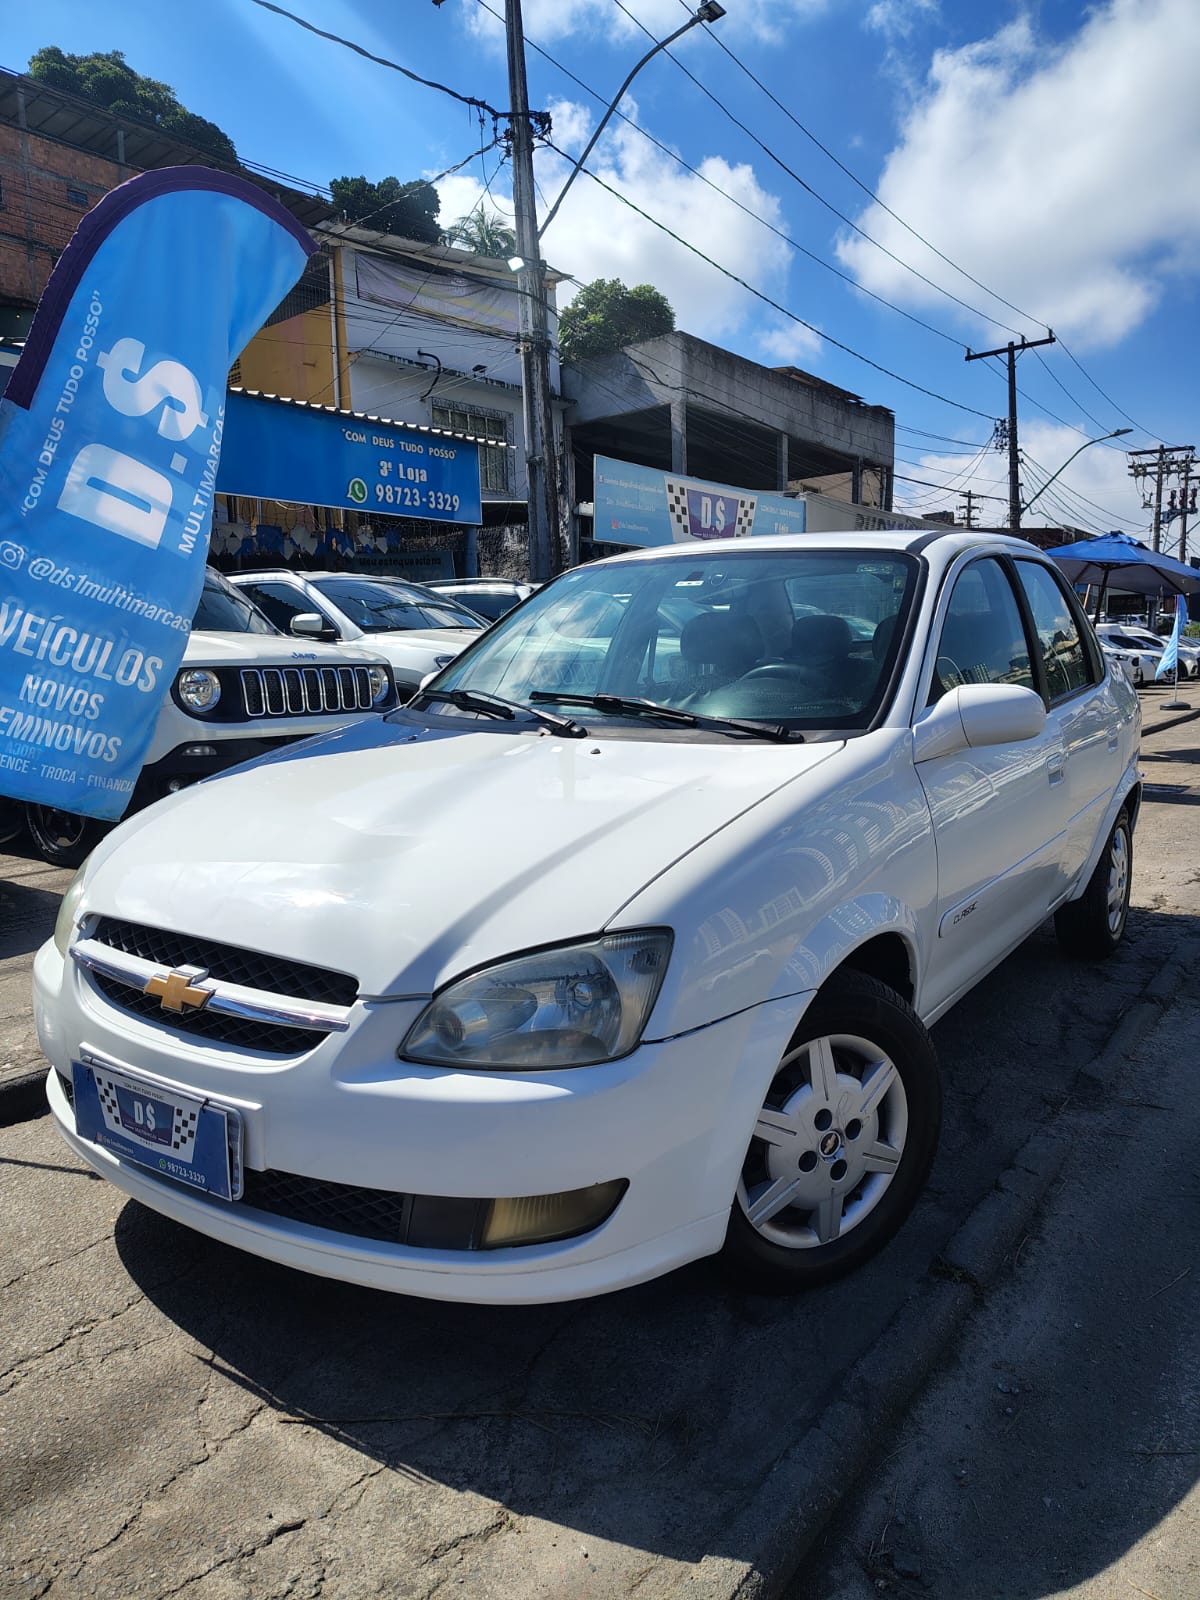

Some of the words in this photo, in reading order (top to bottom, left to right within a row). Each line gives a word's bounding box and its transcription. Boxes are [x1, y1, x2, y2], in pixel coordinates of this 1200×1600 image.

[38, 417, 65, 467] DEUS
[55, 364, 84, 415] TUDO
[372, 436, 395, 449] DEUS
[399, 441, 424, 454] TUDO
[178, 404, 225, 554] MULTIMARCAS
[399, 463, 428, 483] Loja
[375, 483, 460, 512] 98723-3329
[28, 557, 193, 633] @ds1multimarcas
[0, 602, 163, 693] VEÍCULOS
[19, 674, 105, 720] NOVOS
[40, 764, 77, 783] TROCA
[167, 1161, 206, 1185] 98723-3329
